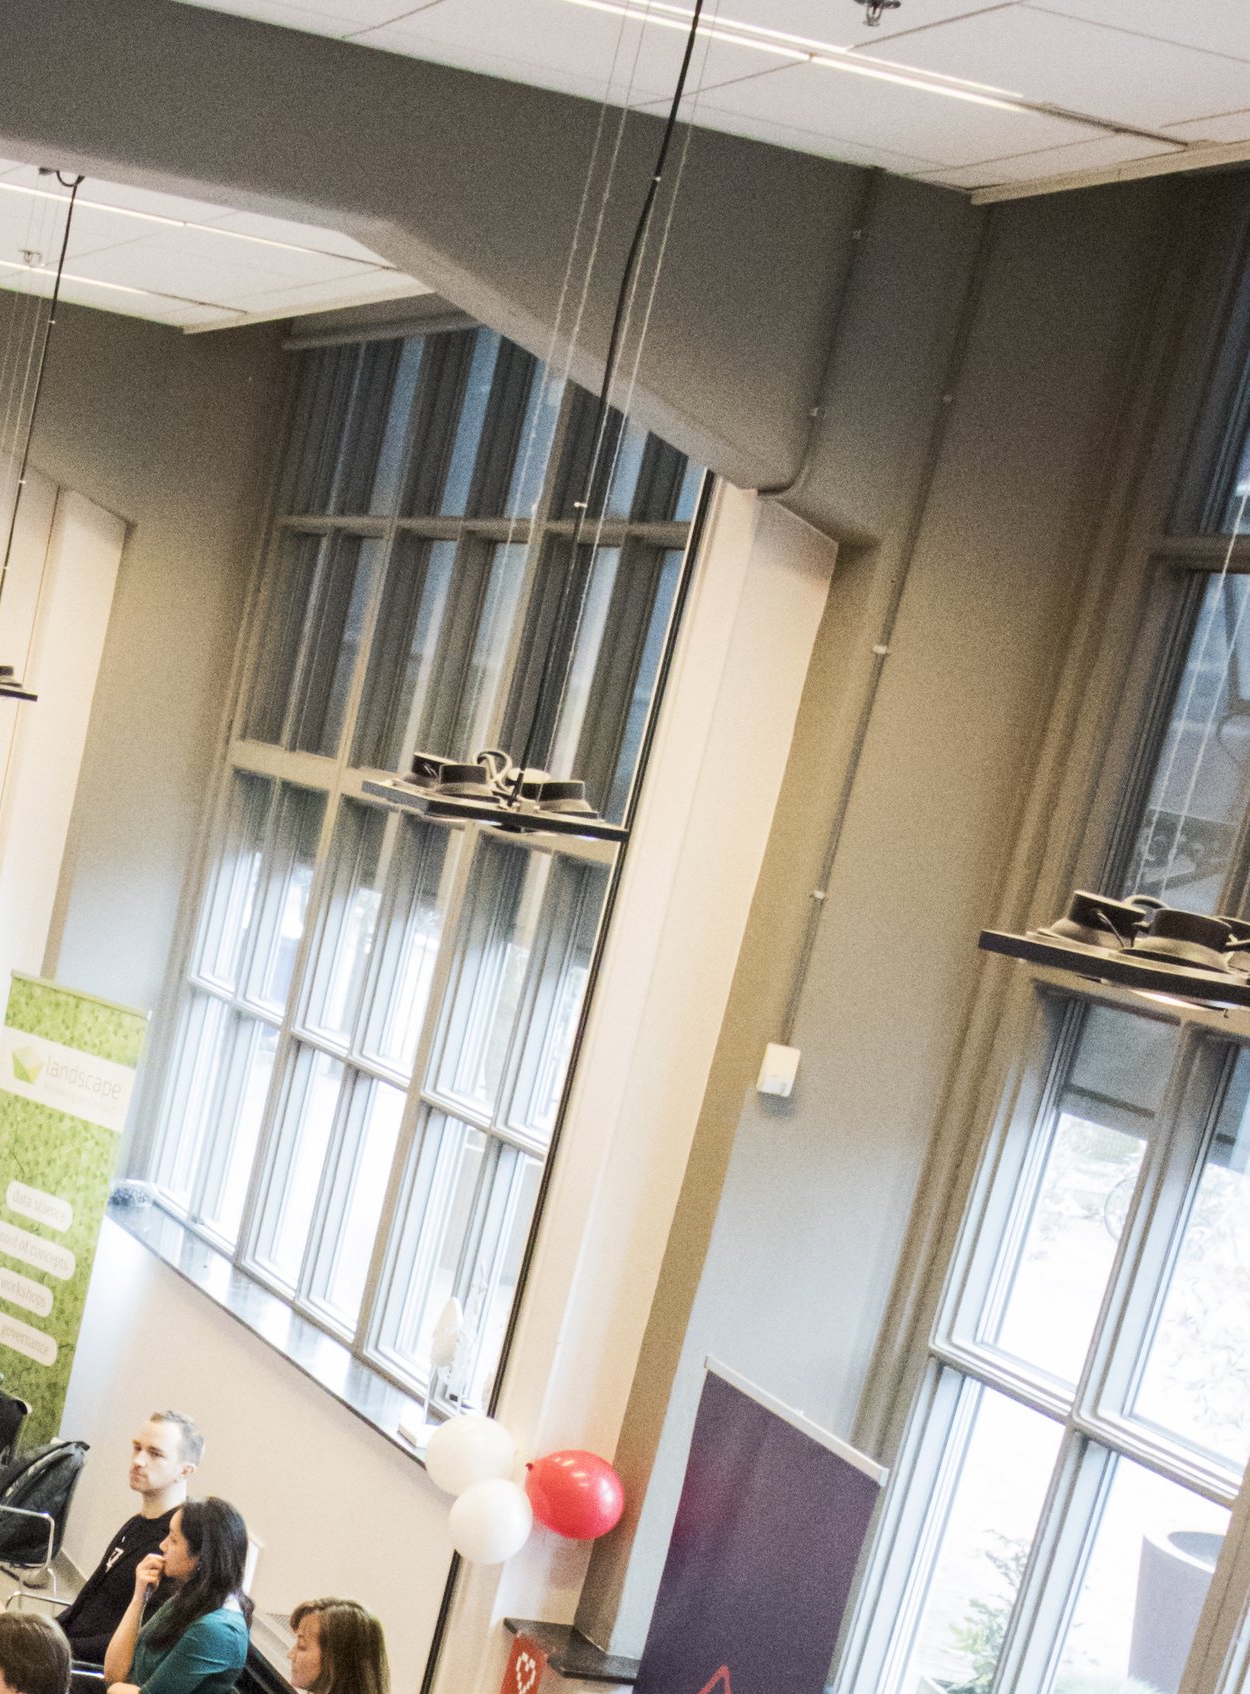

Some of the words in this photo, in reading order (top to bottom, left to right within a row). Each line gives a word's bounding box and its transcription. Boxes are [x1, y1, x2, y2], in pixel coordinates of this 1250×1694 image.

[45, 1055, 123, 1100] landscape
[12, 1189, 33, 1208] data
[29, 1245, 69, 1272] concepts
[0, 1277, 47, 1309] workshops
[0, 1324, 49, 1355] governance
